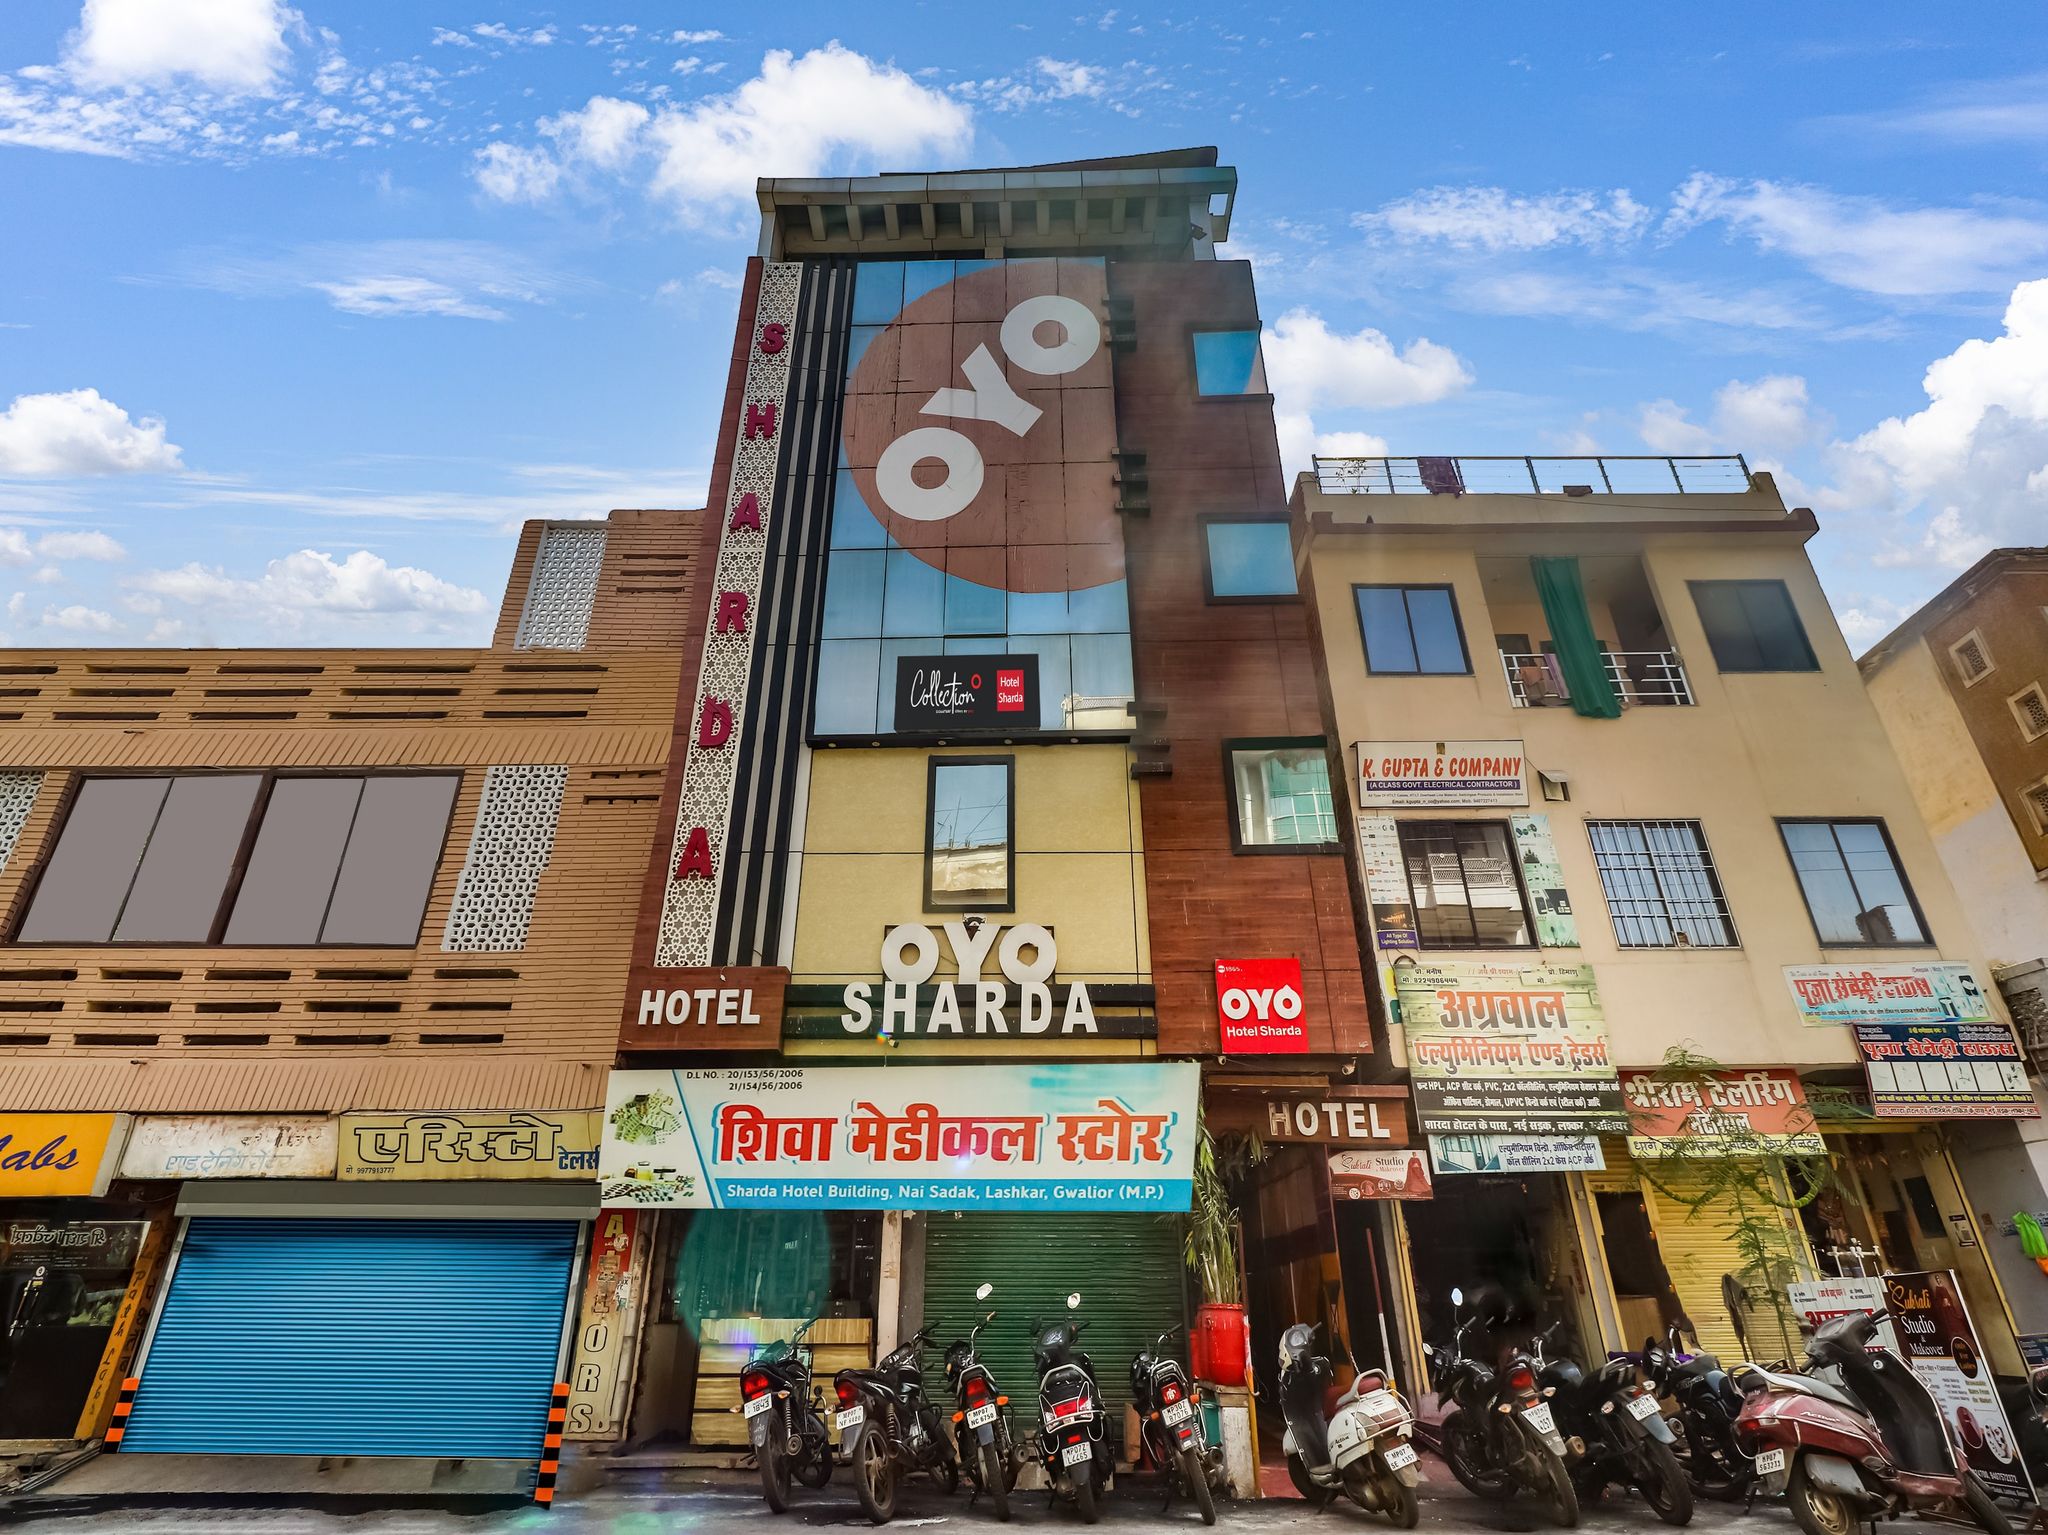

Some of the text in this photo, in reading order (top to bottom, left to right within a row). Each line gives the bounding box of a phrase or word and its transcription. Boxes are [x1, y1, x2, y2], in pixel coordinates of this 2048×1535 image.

[876, 295, 1100, 521] OYO
[677, 323, 787, 877] SHARDA
[1000, 676, 1019, 687] Hotel
[910, 669, 975, 714] Collection
[998, 692, 1023, 703] Sharda
[1362, 756, 1521, 779] K. GUPTA & COMPANY
[1369, 780, 1513, 790] (A CLASS GOVT. ELECTRICAL CONTRACTOR
[881, 922, 1057, 985] OYO
[637, 989, 761, 1027] HOTEL
[841, 981, 1099, 1034] SHARDA
[1221, 984, 1302, 1020] OYO
[1437, 990, 1569, 1030] अग्रवाल
[1226, 1025, 1303, 1038] Hotel Sharda
[1414, 1035, 1608, 1074] एल्युमिनियम एण्ड ट्रेडर्स
[1861, 1038, 2017, 1061] पूजा सेनेट्री हाऊस
[703, 1071, 719, 1080] NO.
[727, 1069, 804, 1080] 20/153/56/2006
[729, 1081, 803, 1091] 21/154/56/2006
[1428, 1081, 1445, 1092] HPL,
[1446, 1081, 1460, 1091] ACP
[1485, 1082, 1502, 1092] PVC,
[1502, 1082, 1516, 1091] 2x2
[1704, 1072, 1797, 1107] टेलरिंग
[1504, 1098, 1524, 1107] UPVC
[1268, 1102, 1390, 1138] HOTEL
[1424, 1120, 1451, 1130] शारदा
[1452, 1118, 1477, 1130] होटल
[1478, 1118, 1488, 1130] के
[1513, 1119, 1527, 1131] नई
[354, 1113, 562, 1163] एरिस्टो
[718, 1099, 1168, 1162] शिवा मेडीकल स्टोर
[166, 1155, 200, 1171] एण्ड
[1376, 1156, 1404, 1166] Studio
[1542, 1156, 1555, 1166] 2x2
[1568, 1155, 1582, 1165] ACP
[727, 1183, 1164, 1200] Sharda Hotel Building, Nai Sadak, Lashkar, Gwalior (M.P.)
[1900, 1315, 1936, 1334] Studio
[1909, 1342, 1945, 1355] Makeover
[972, 1407, 989, 1417] MP07
[1391, 1448, 1406, 1459] MP07
[1391, 1453, 1415, 1470] SE 1357
[1762, 1453, 1776, 1463] MP07
